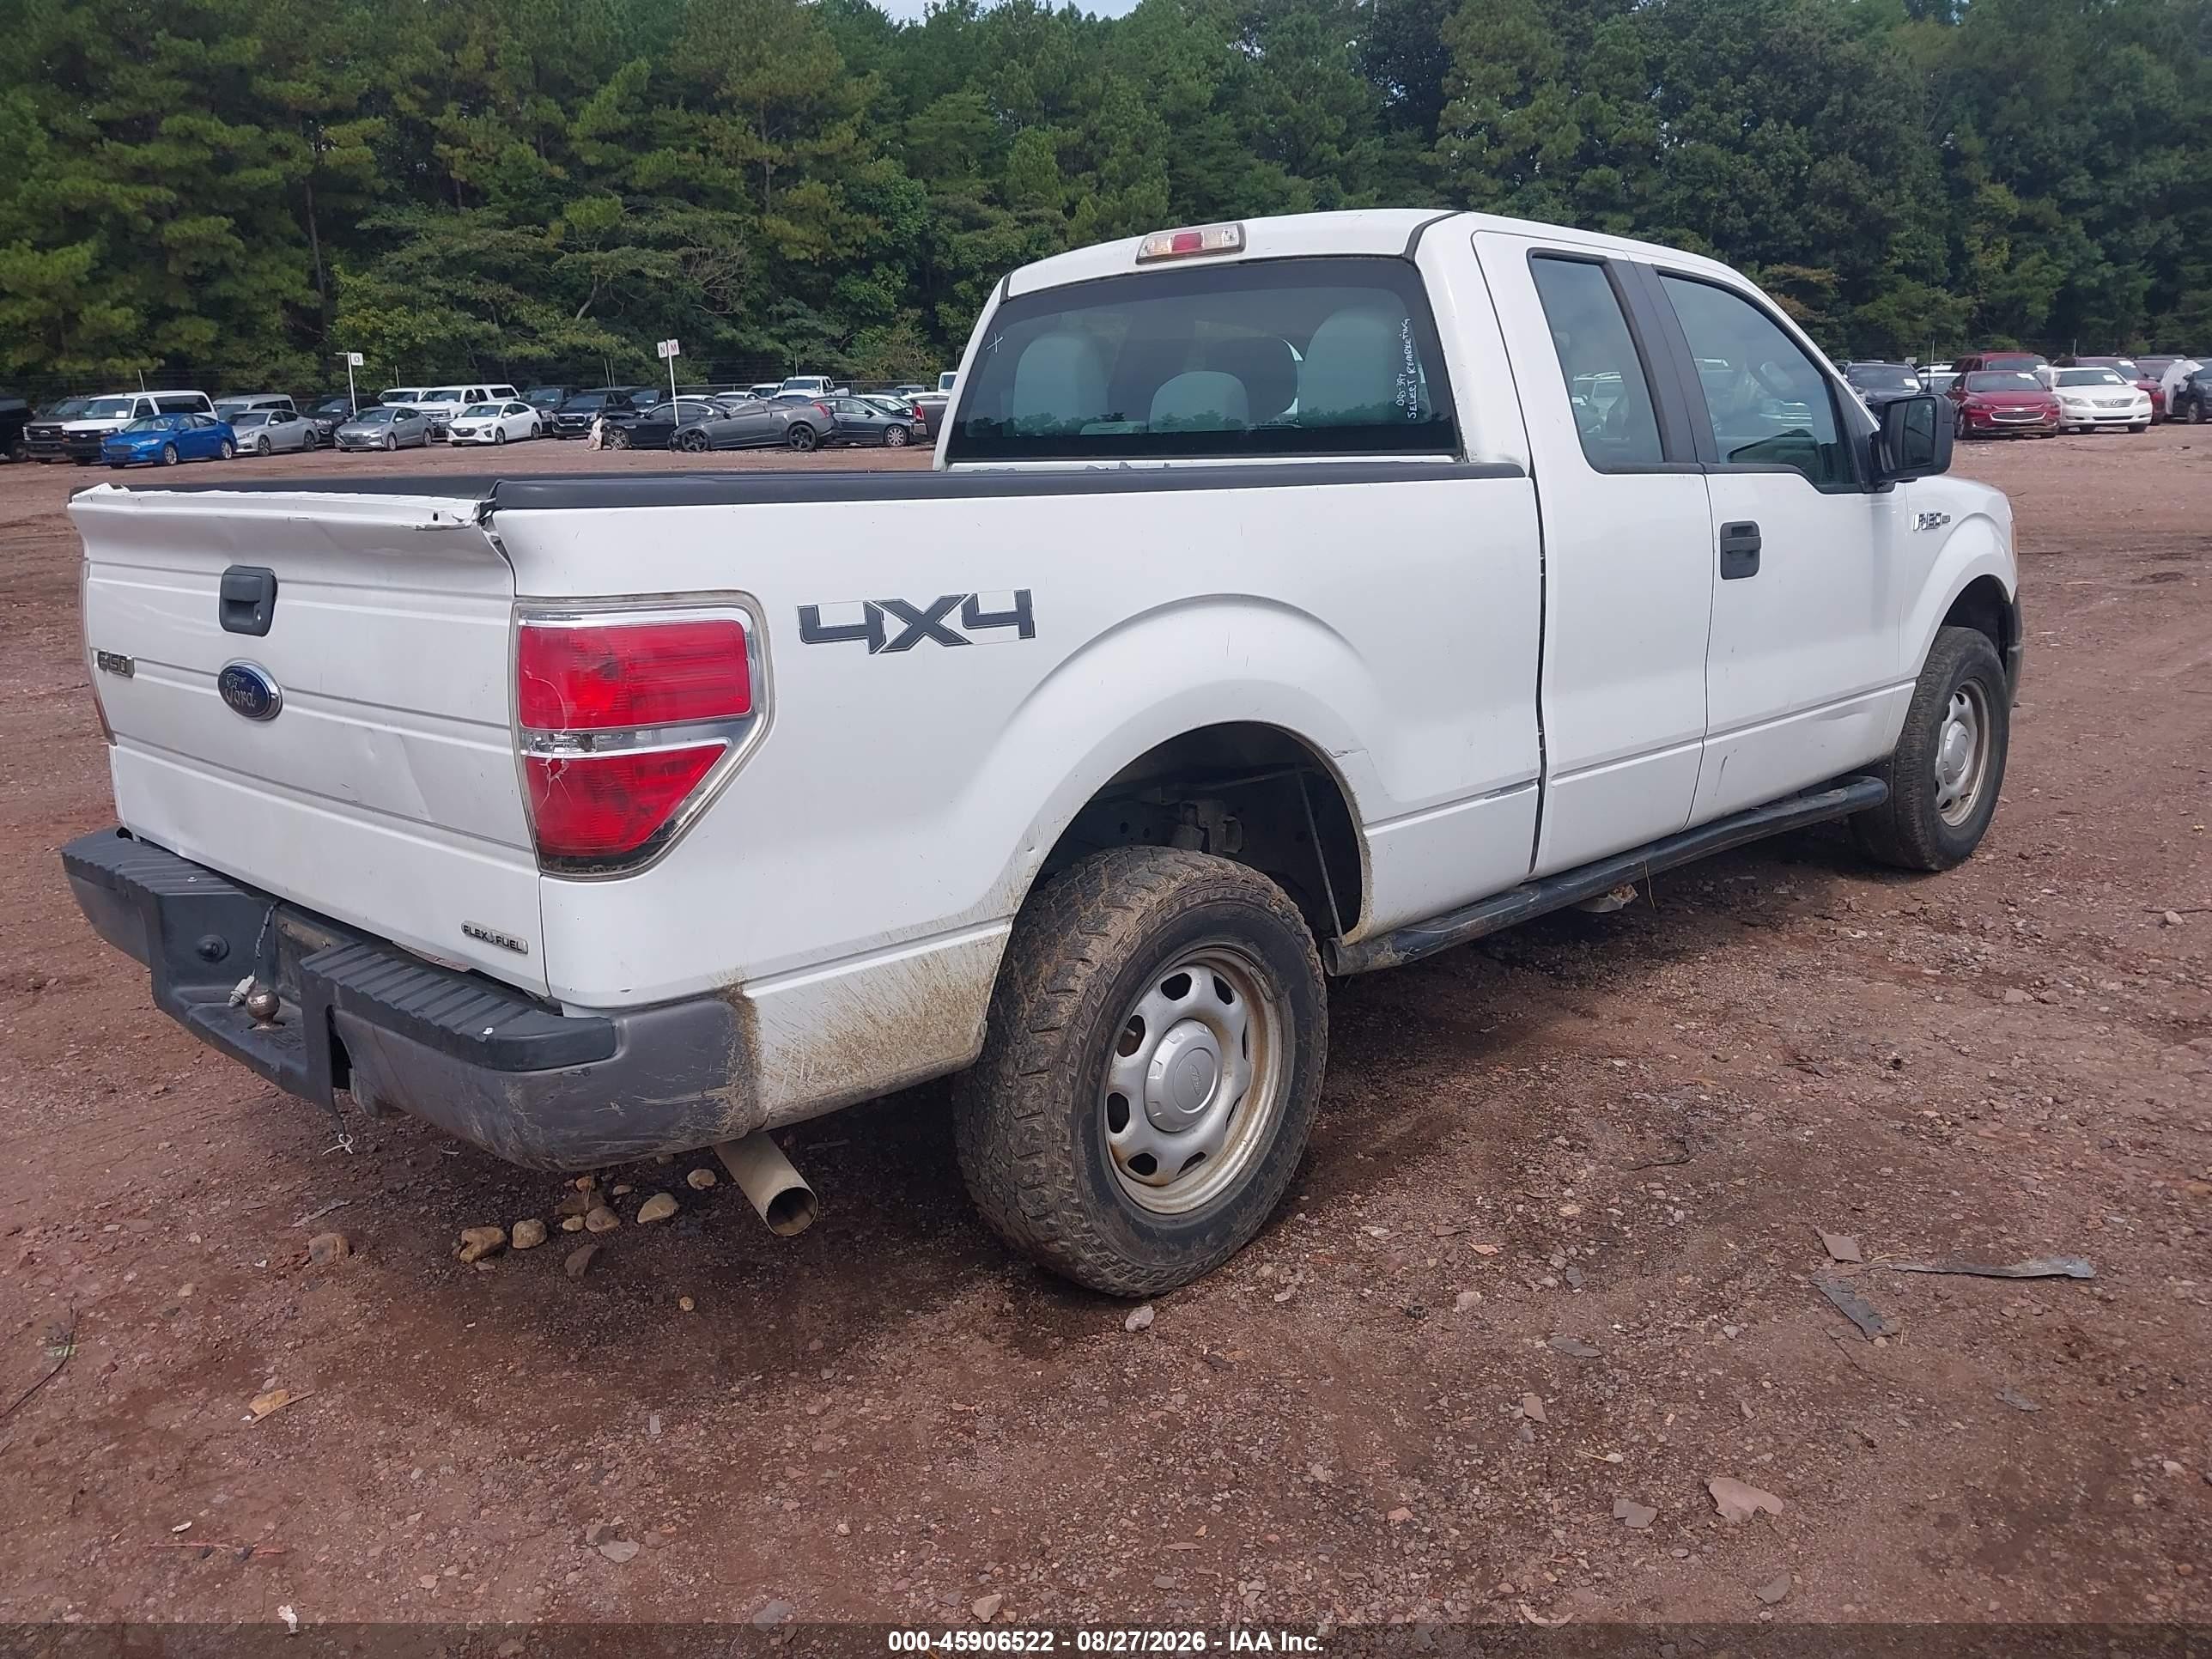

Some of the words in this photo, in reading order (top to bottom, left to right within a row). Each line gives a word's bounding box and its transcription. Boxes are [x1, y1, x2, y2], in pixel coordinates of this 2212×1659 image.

[1407, 380, 1417, 420] SELECT
[225, 672, 257, 708] Ford
[462, 924, 489, 942] FLEX
[495, 935, 523, 951] FUEL
